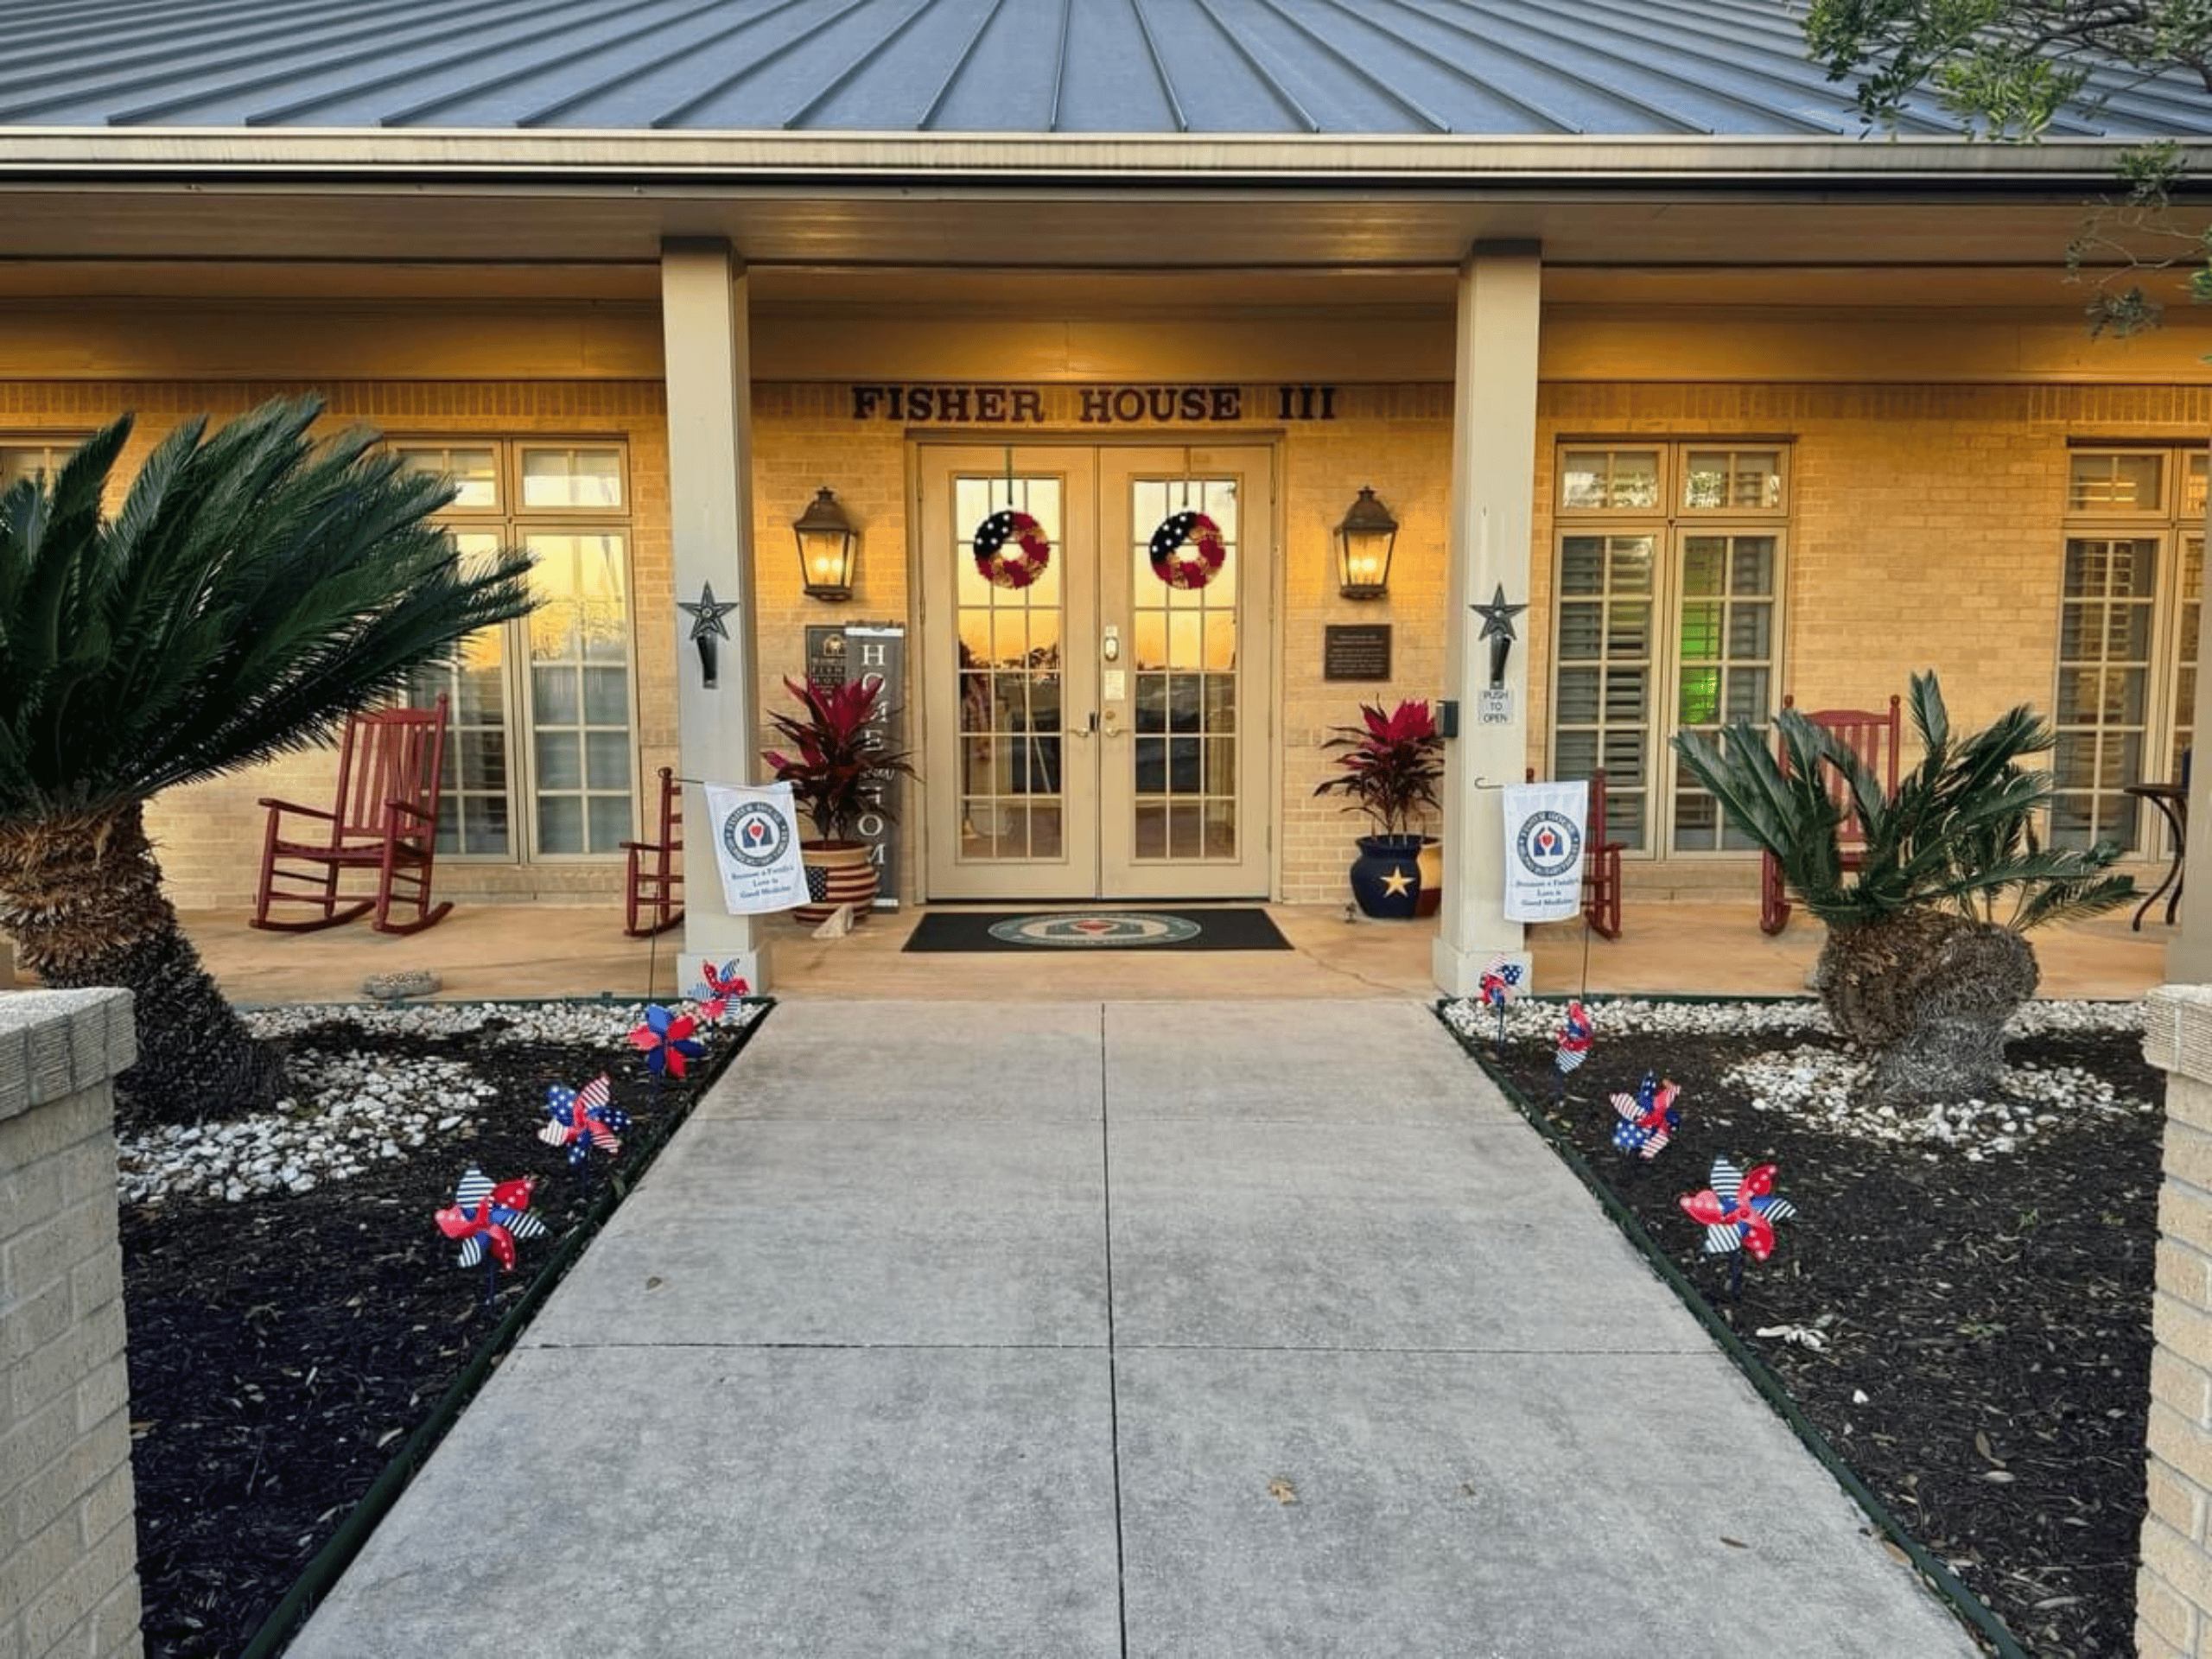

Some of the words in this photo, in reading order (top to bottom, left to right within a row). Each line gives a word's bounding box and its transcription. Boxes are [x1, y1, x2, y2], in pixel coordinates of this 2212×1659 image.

[852, 386, 1046, 422] FISHER
[1079, 387, 1242, 422] HOUSE
[1278, 386, 1337, 420] III
[1483, 690, 1509, 700] PUSH
[1491, 702, 1503, 711] TO
[1483, 713, 1508, 722] OPEN
